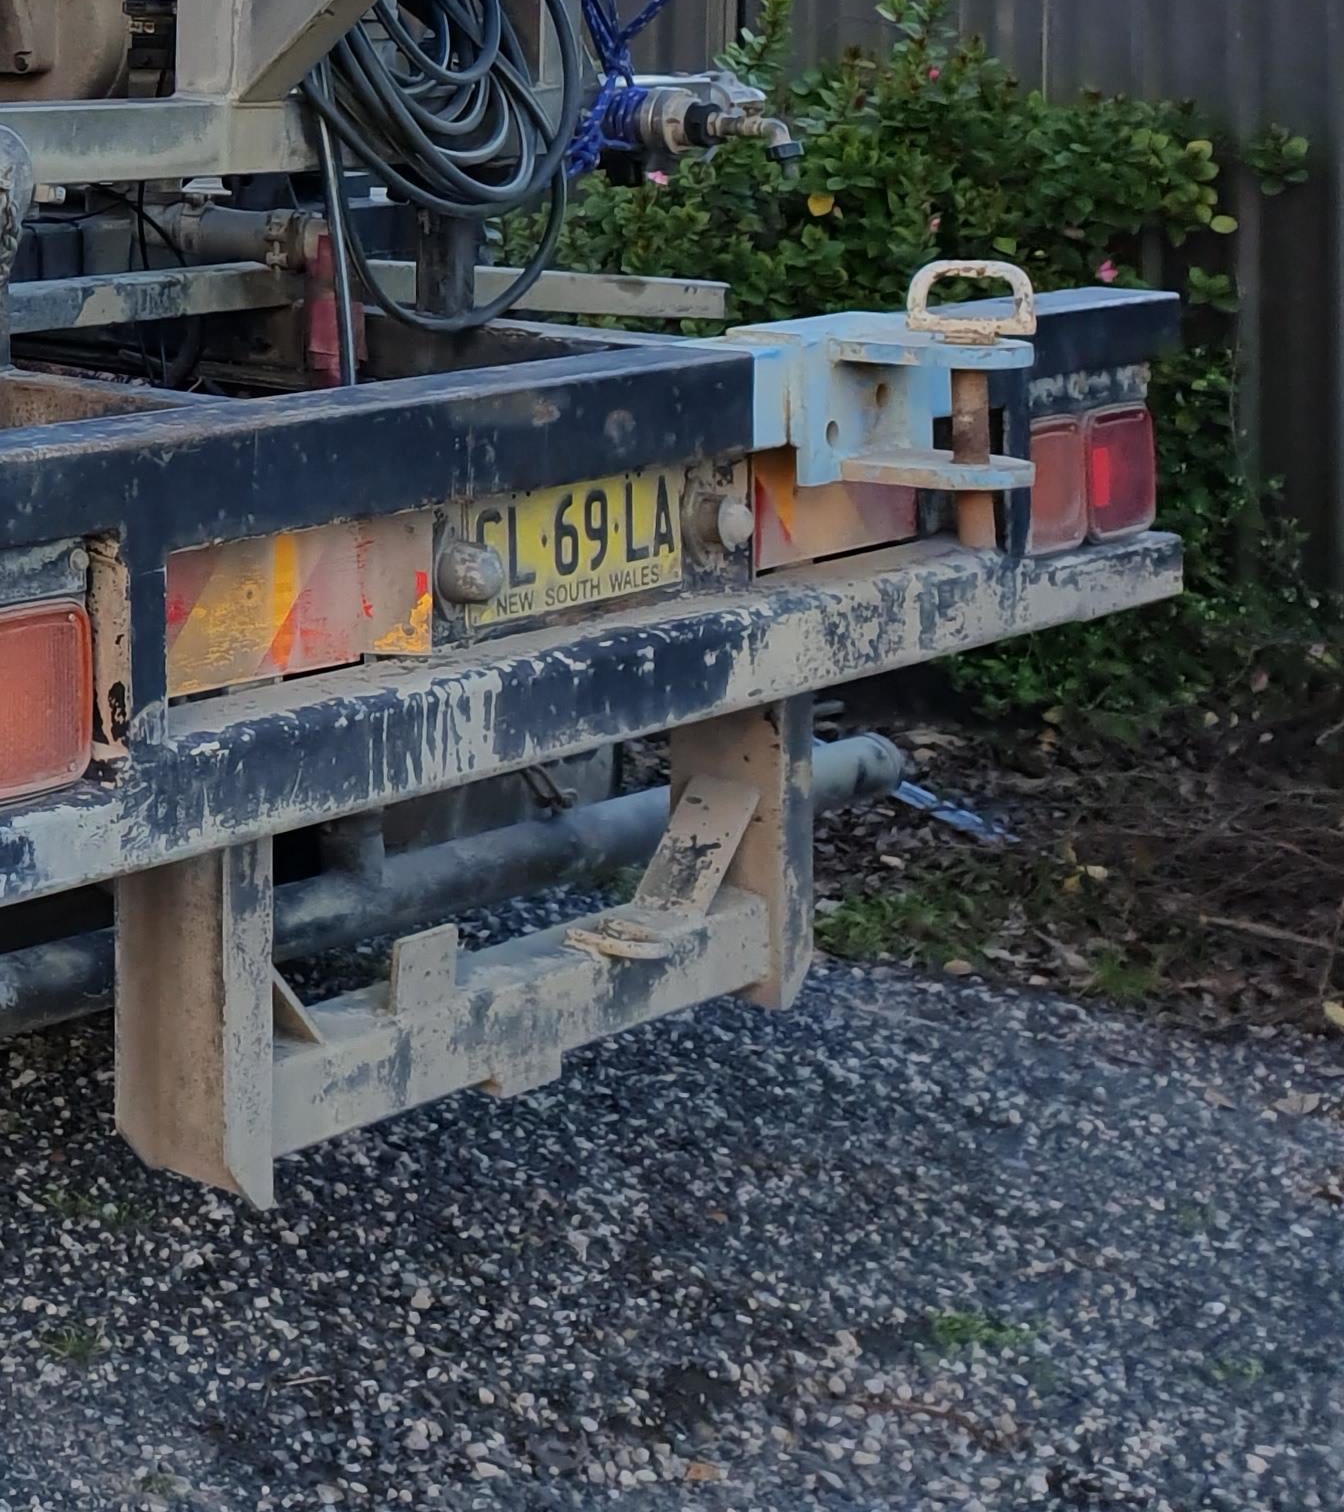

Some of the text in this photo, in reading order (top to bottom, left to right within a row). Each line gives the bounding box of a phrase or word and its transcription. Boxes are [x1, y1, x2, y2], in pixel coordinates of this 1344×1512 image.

[496, 564, 660, 617] NEW SOUTH WALES
